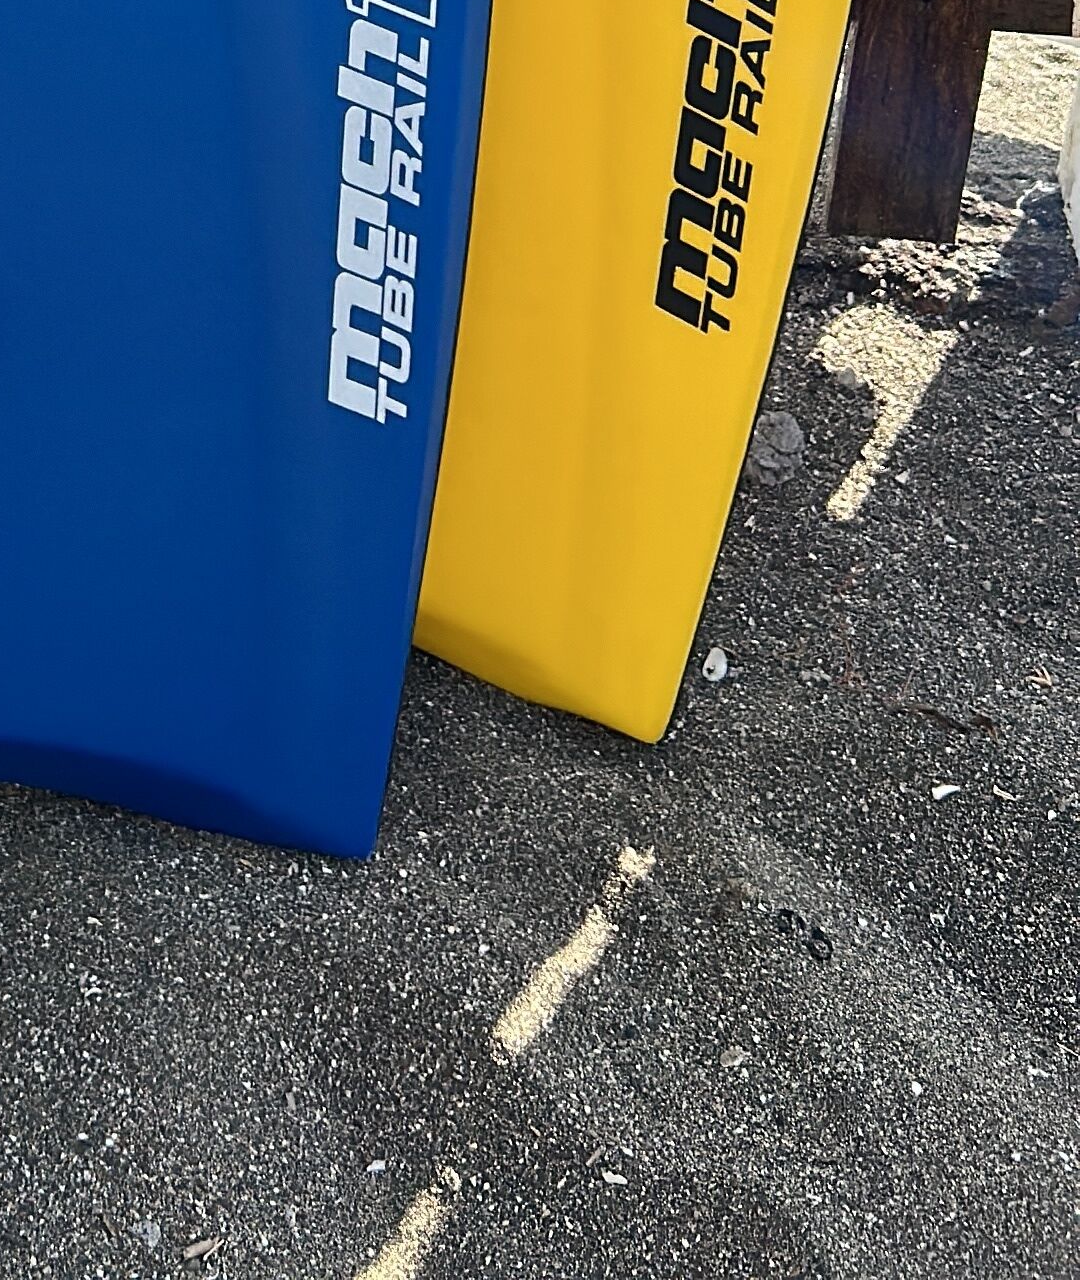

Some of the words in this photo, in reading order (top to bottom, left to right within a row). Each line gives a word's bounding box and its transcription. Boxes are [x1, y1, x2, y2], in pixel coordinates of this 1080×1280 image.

[391, 37, 429, 207] RAIL
[375, 224, 418, 424] TUBE
[700, 150, 753, 334] TUBE
